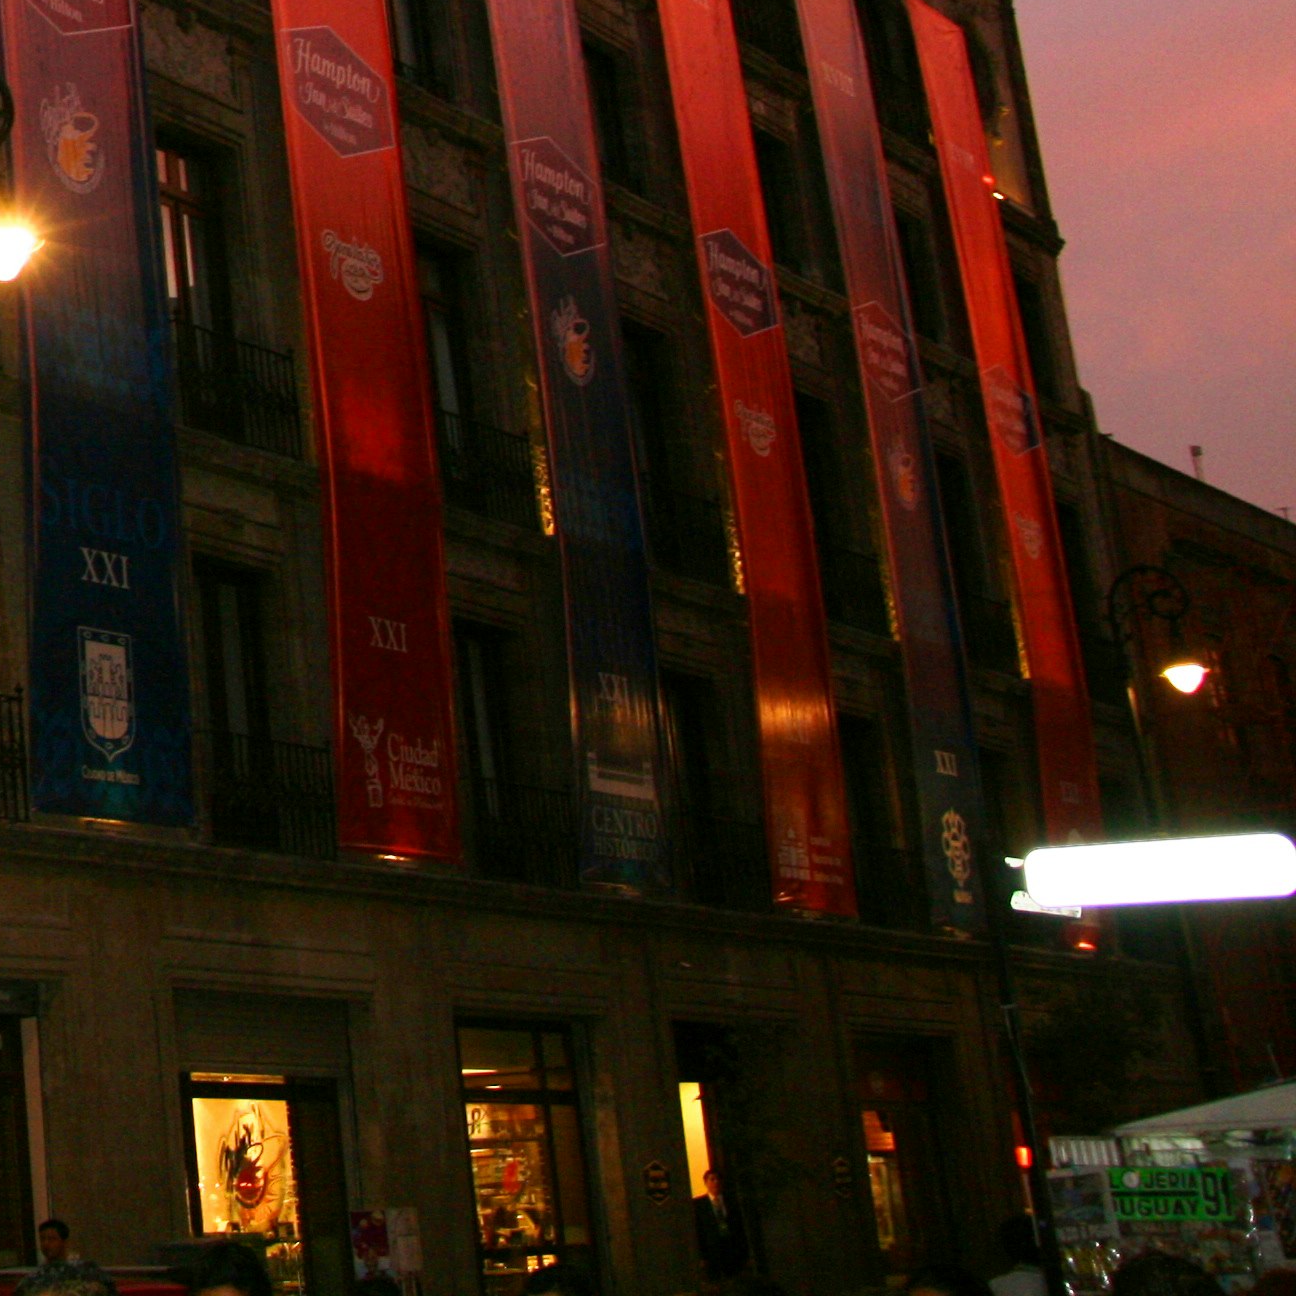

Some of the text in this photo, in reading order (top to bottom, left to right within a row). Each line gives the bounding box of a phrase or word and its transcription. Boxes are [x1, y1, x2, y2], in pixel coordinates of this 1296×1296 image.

[288, 37, 381, 104] Hampton
[518, 148, 592, 206] Hampton
[80, 546, 131, 590] XXI
[368, 615, 408, 654] XXI
[598, 671, 631, 710] XXI
[387, 732, 439, 768] Ciudad
[934, 749, 959, 778] XXI
[388, 760, 442, 797] México
[591, 805, 658, 840] CENTRO
